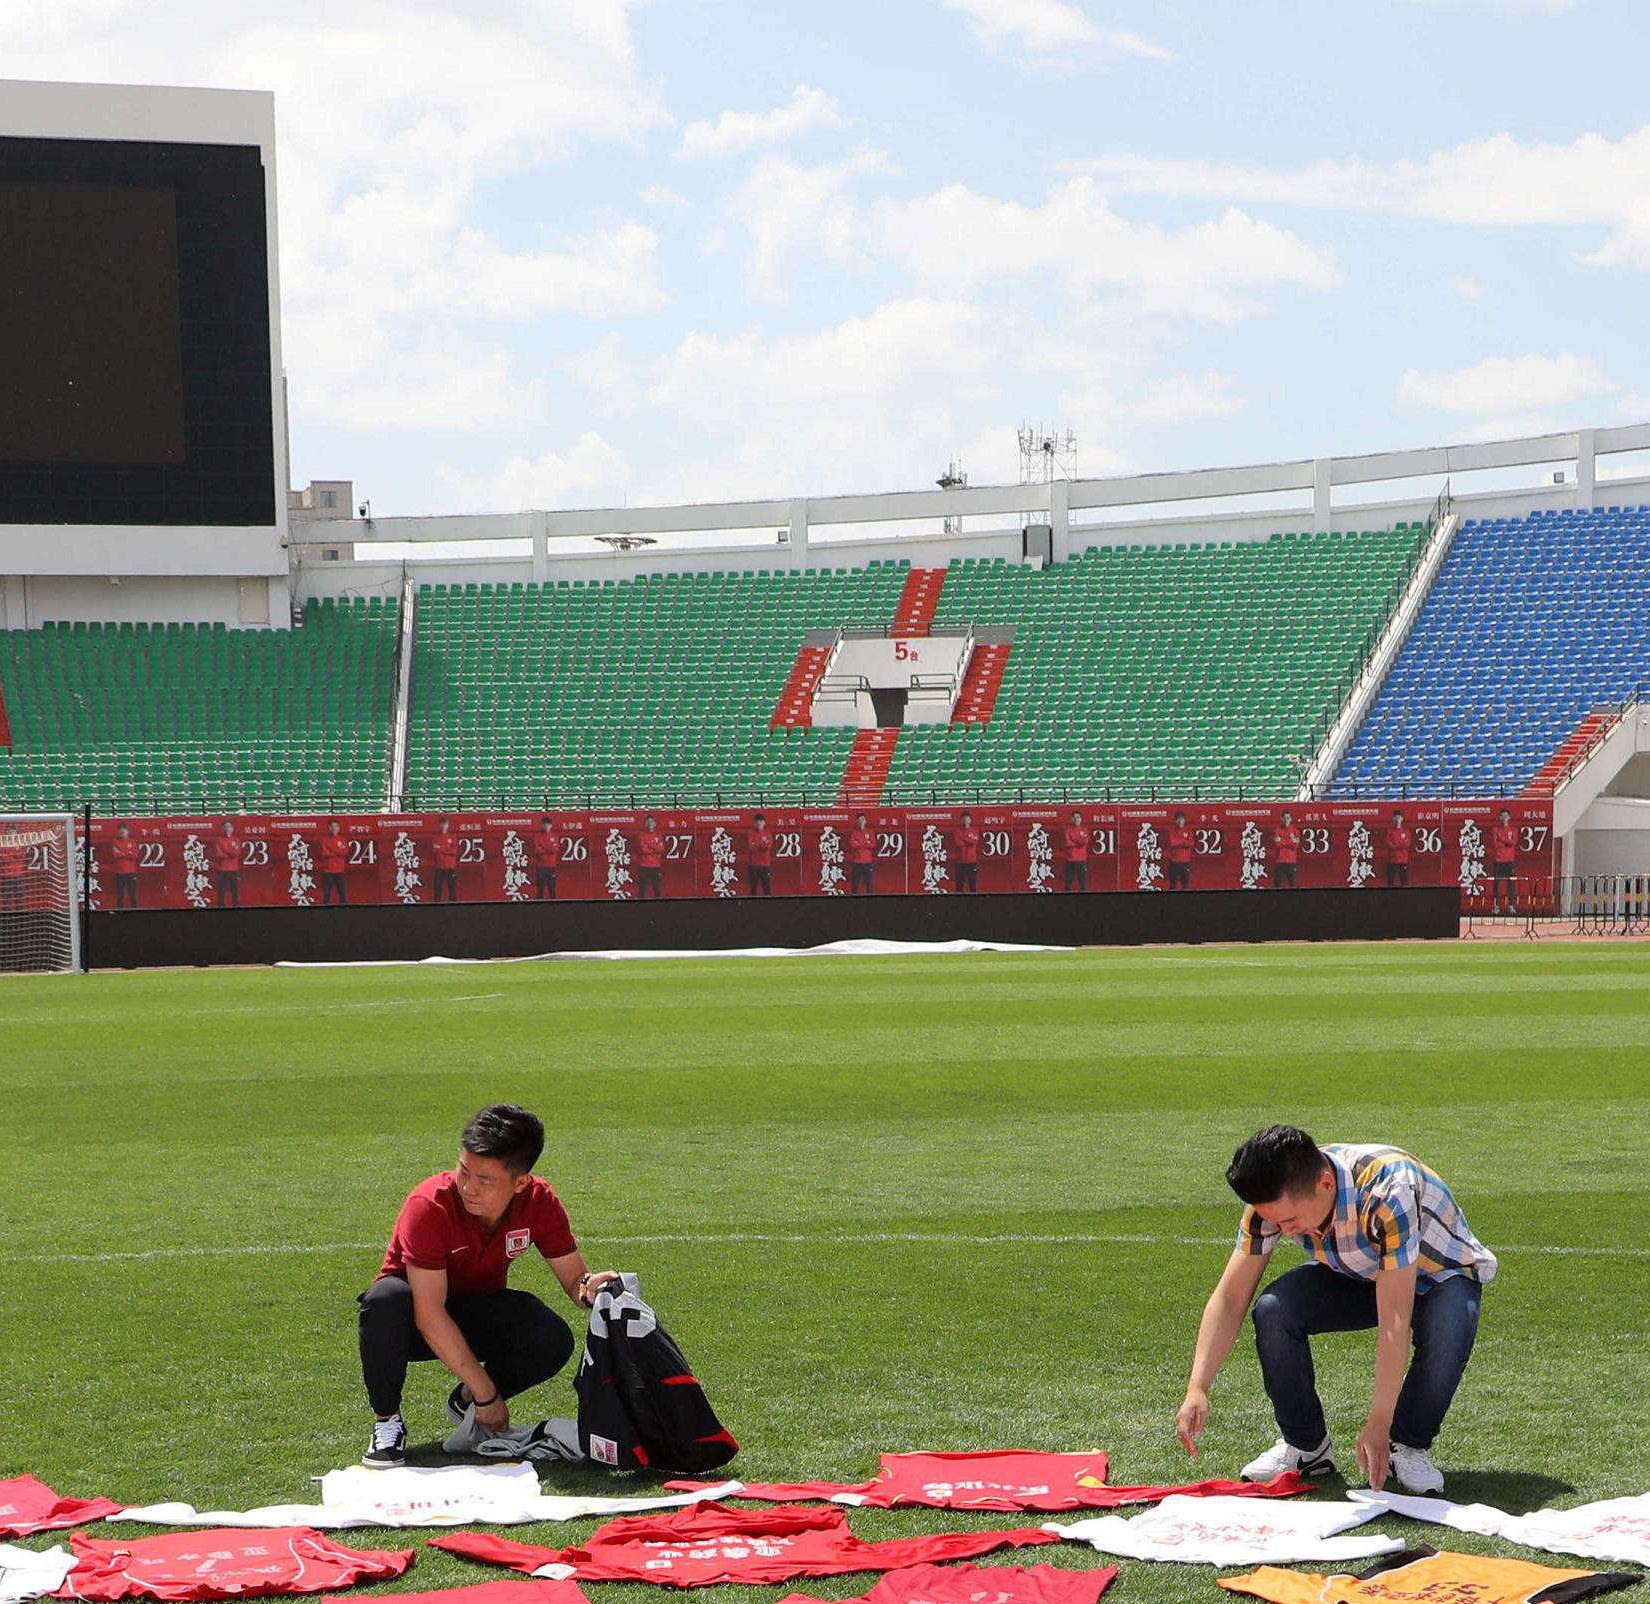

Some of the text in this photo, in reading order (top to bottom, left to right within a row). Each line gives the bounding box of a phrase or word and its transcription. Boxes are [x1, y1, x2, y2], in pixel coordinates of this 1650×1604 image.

[895, 641, 919, 661] 5台
[458, 838, 485, 862] 25
[561, 837, 588, 861] 26
[664, 835, 693, 859] 27
[775, 834, 801, 858] 28
[876, 833, 903, 857] 29
[982, 832, 1010, 856] 30
[1092, 830, 1116, 854] 31
[1195, 830, 1222, 854] 32
[1301, 828, 1330, 853] 33
[1414, 828, 1443, 852] 36
[1519, 827, 1548, 851] 37
[26, 847, 50, 871] 21
[138, 843, 166, 868] 22
[241, 841, 270, 865] 23
[348, 840, 377, 864] 24
